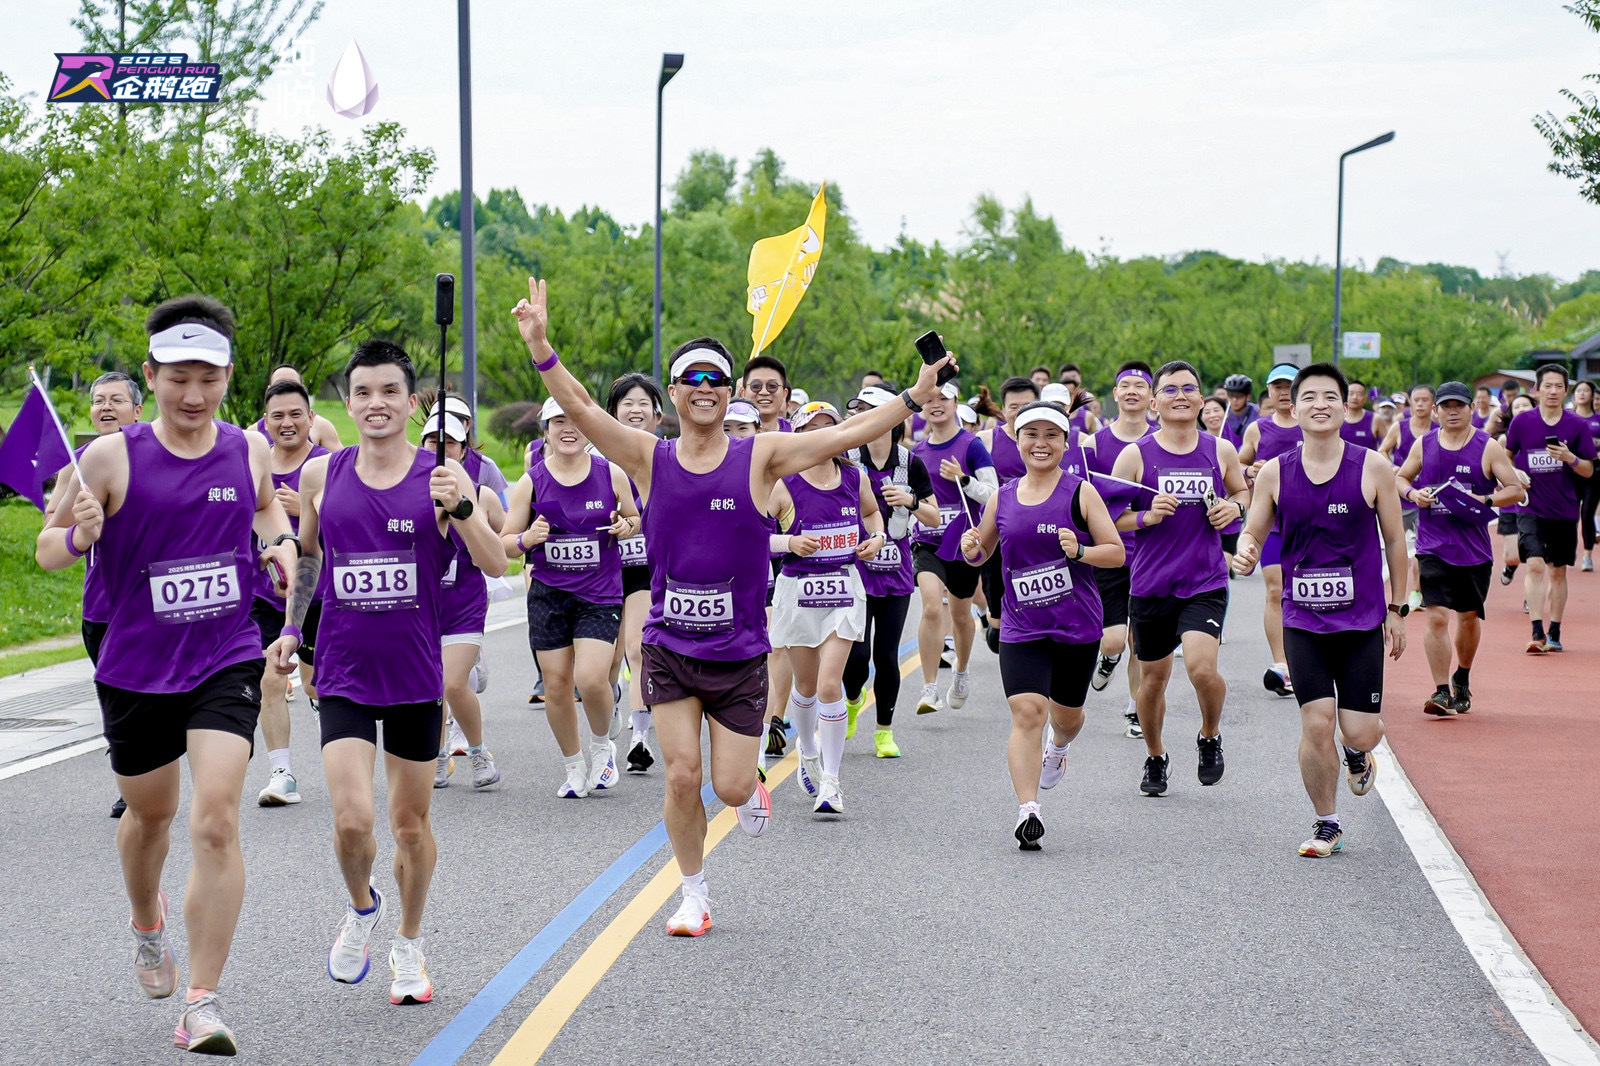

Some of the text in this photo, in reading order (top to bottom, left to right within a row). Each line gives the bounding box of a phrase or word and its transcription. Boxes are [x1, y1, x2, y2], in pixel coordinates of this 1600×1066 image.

[208, 487, 237, 501] 纯悦
[1164, 479, 1208, 494] 0240
[585, 500, 604, 509] 纯悦
[710, 498, 735, 510] 纯悦
[1328, 503, 1348, 514] 纯悦
[387, 518, 415, 532] 纯悦
[1037, 523, 1058, 533] 纯悦
[820, 532, 858, 550] 救跑者
[550, 545, 594, 560] 0183
[618, 541, 644, 557] 015
[876, 548, 898, 561] 418
[161, 573, 230, 605] 0275
[342, 569, 408, 594] 0318
[803, 580, 848, 596] 0351
[1019, 573, 1066, 597] 0408
[1298, 581, 1347, 598] 0198
[670, 596, 726, 617] 0265
